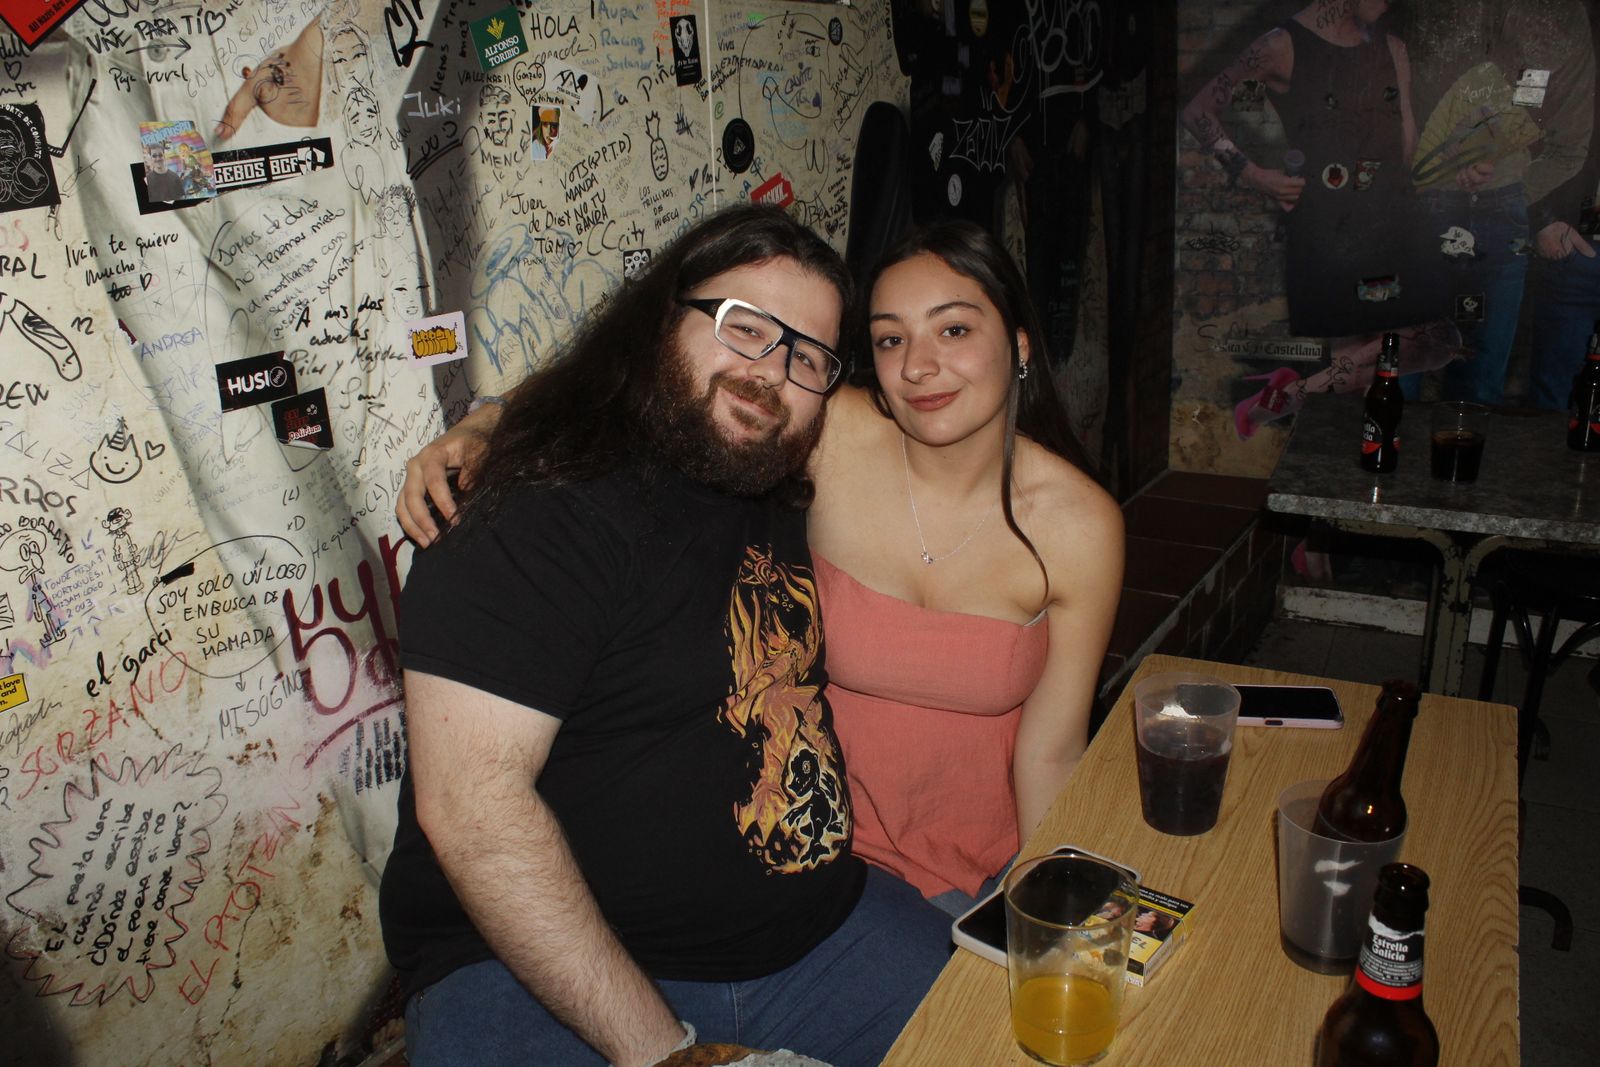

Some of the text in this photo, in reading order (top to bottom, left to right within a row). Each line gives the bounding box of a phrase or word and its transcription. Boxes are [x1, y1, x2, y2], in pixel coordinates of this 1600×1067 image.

[531, 14, 580, 41] HOLA
[484, 35, 519, 58] ALFONSO
[488, 47, 520, 67] TORIBIO
[565, 173, 599, 203] MANDA
[591, 189, 606, 209] TU
[511, 192, 547, 215] Juan
[528, 217, 541, 233] de
[108, 234, 127, 252] te
[136, 231, 179, 257] quiero
[140, 327, 203, 362] ANDREA
[1265, 344, 1321, 356] Castellana
[156, 587, 188, 615] SOY
[197, 574, 233, 597] SOLO
[266, 563, 307, 582] LOBO
[196, 624, 220, 646] SU
[201, 626, 275, 661] MAMADA
[1, 685, 17, 697] and
[3, 679, 21, 689] love
[1372, 934, 1408, 952] Estrella
[1372, 944, 1406, 961] Galicia
